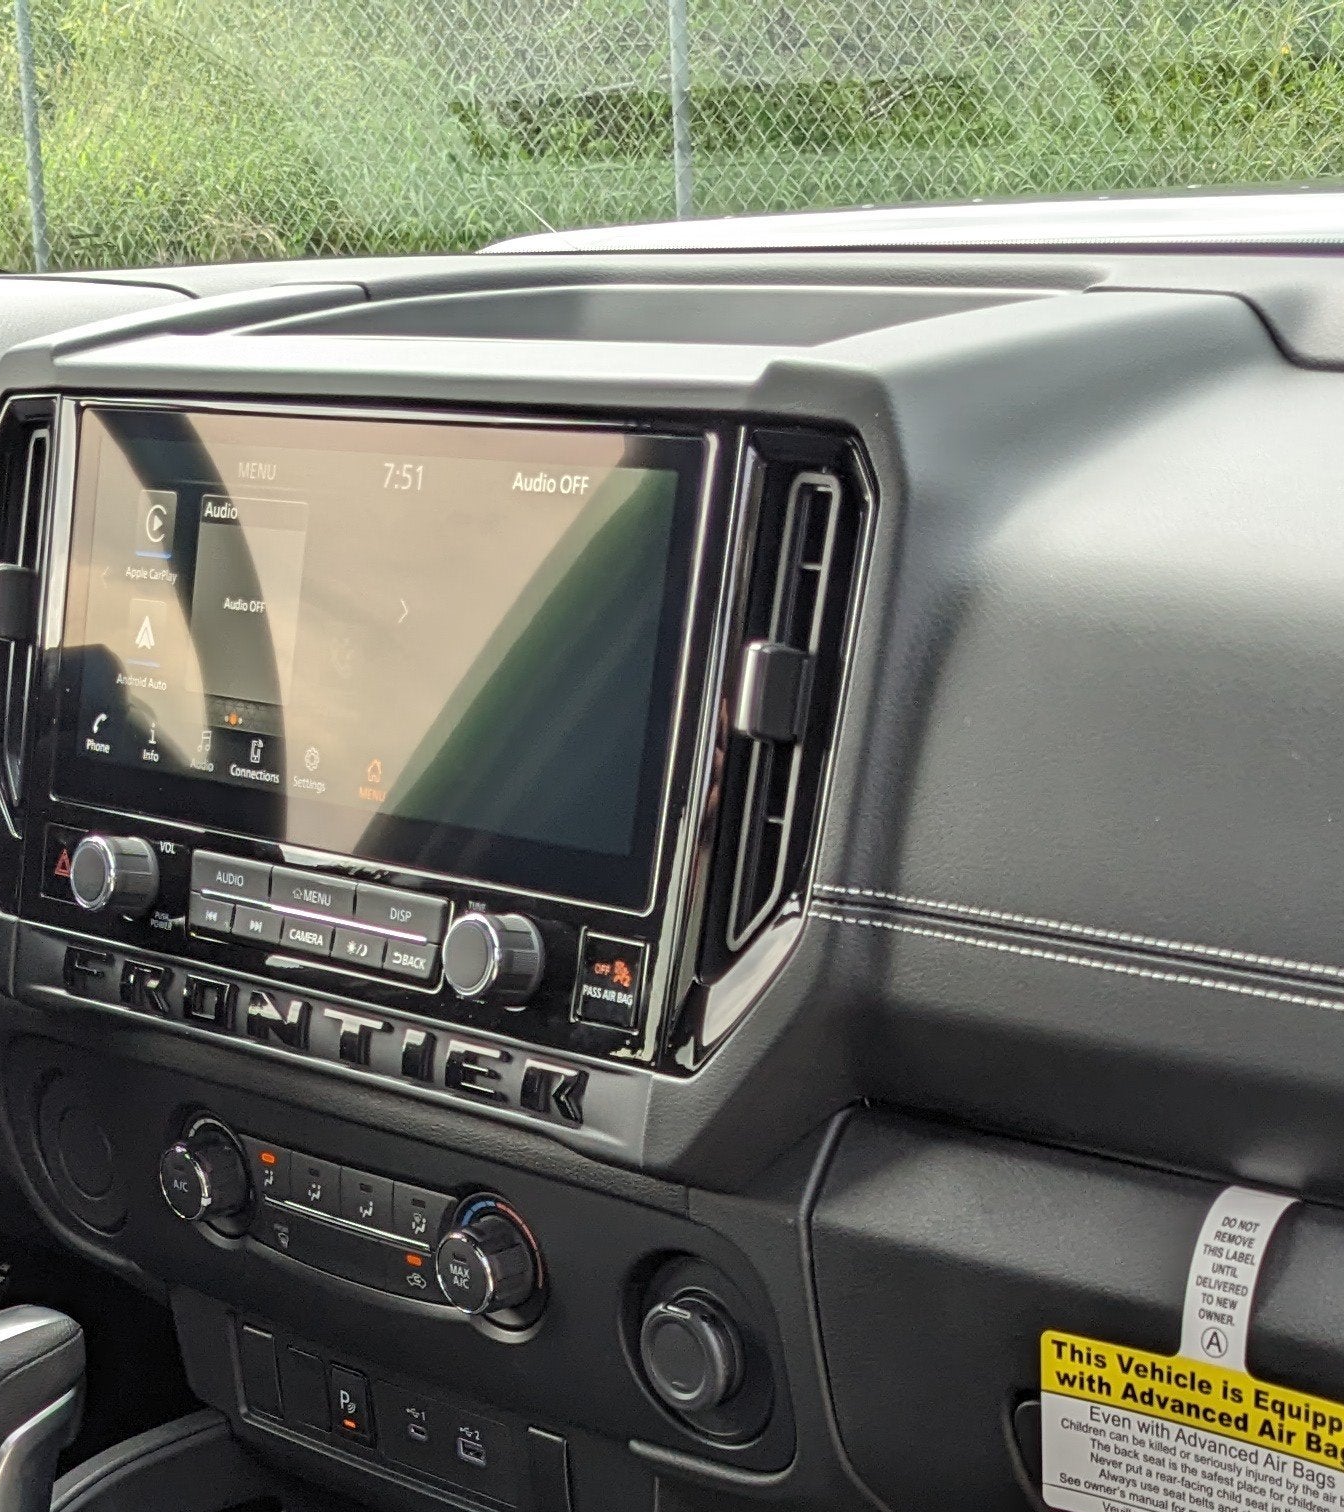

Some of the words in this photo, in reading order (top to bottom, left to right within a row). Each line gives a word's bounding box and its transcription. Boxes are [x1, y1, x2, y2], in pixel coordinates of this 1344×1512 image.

[238, 462, 277, 481] MENU
[383, 462, 424, 491] 7:51
[512, 472, 557, 494] Audio
[560, 474, 590, 496] OFF
[204, 502, 239, 520] Audio
[125, 566, 149, 581] Apple
[149, 567, 178, 586] CarPlay
[223, 597, 248, 613] Audio
[249, 600, 267, 614] OFF
[116, 673, 148, 689] Android
[148, 675, 168, 692] Auto
[86, 738, 110, 755] Phone
[143, 749, 160, 763] Info
[190, 758, 215, 773] Audio
[230, 764, 280, 785] Connections
[293, 775, 327, 794] Settings
[160, 841, 176, 855] VOL
[216, 870, 244, 888] AUDIO
[303, 887, 333, 908] MENU
[390, 905, 412, 924] DISP
[289, 928, 324, 947] CAMERA
[402, 952, 426, 972] BACK
[593, 962, 611, 977] OFF
[582, 985, 603, 1001] PASS
[602, 988, 617, 1003] AIR
[616, 991, 634, 1007] BAG
[64, 945, 591, 1128] FRONTIER
[173, 1178, 190, 1194] A/C
[1221, 1215, 1237, 1229] DO
[1237, 1219, 1262, 1234] NOT
[1213, 1230, 1256, 1249] REMOVE
[1202, 1243, 1224, 1260] THIS
[1225, 1249, 1256, 1266] LABEL
[449, 1263, 471, 1281] MAX
[1211, 1262, 1239, 1279] UNTIL
[453, 1276, 470, 1291] A/C
[1195, 1275, 1249, 1298] DELIVERED
[1201, 1292, 1214, 1306] TO
[1216, 1295, 1239, 1310] NEW
[1198, 1308, 1235, 1327] OWNER.
[1051, 1339, 1107, 1369] This
[1117, 1354, 1212, 1396] Vehicle
[1222, 1380, 1244, 1404] is
[1056, 1371, 1112, 1397] with
[1121, 1382, 1249, 1433] Advanced
[1258, 1419, 1297, 1445] Air
[1090, 1405, 1131, 1430] Even
[1137, 1420, 1170, 1441] with
[1174, 1428, 1259, 1465] Advanced
[1263, 1453, 1287, 1473] Air
[1293, 1460, 1336, 1489] Bags
[1061, 1417, 1107, 1438] Children
[1109, 1431, 1128, 1444] can
[1132, 1435, 1146, 1448] be
[1149, 1439, 1177, 1457] killed
[1179, 1450, 1191, 1460] or
[1194, 1454, 1243, 1478] seriously
[1245, 1466, 1283, 1488] injured
[1286, 1478, 1299, 1495] by
[1302, 1484, 1321, 1499] the
[1321, 1488, 1338, 1504] air
[1090, 1437, 1111, 1453] The
[1114, 1443, 1140, 1461] back
[1142, 1454, 1166, 1468] seat
[1168, 1458, 1178, 1471] is
[1180, 1462, 1198, 1477] the
[1201, 1470, 1234, 1488] safest
[1237, 1480, 1267, 1497] place
[1269, 1488, 1285, 1502] for
[1059, 1472, 1081, 1487] See
[1129, 1492, 1169, 1511] manual
[1090, 1452, 1123, 1470] Never
[1125, 1463, 1143, 1476] put
[1145, 1469, 1153, 1479] a
[1155, 1471, 1214, 1498] rear-facing
[1216, 1488, 1242, 1504] child
[1245, 1497, 1268, 1512] seat
[1098, 1468, 1138, 1488] Always
[1140, 1481, 1160, 1494] use
[1163, 1488, 1186, 1502] seat
[1189, 1493, 1215, 1511] belts
